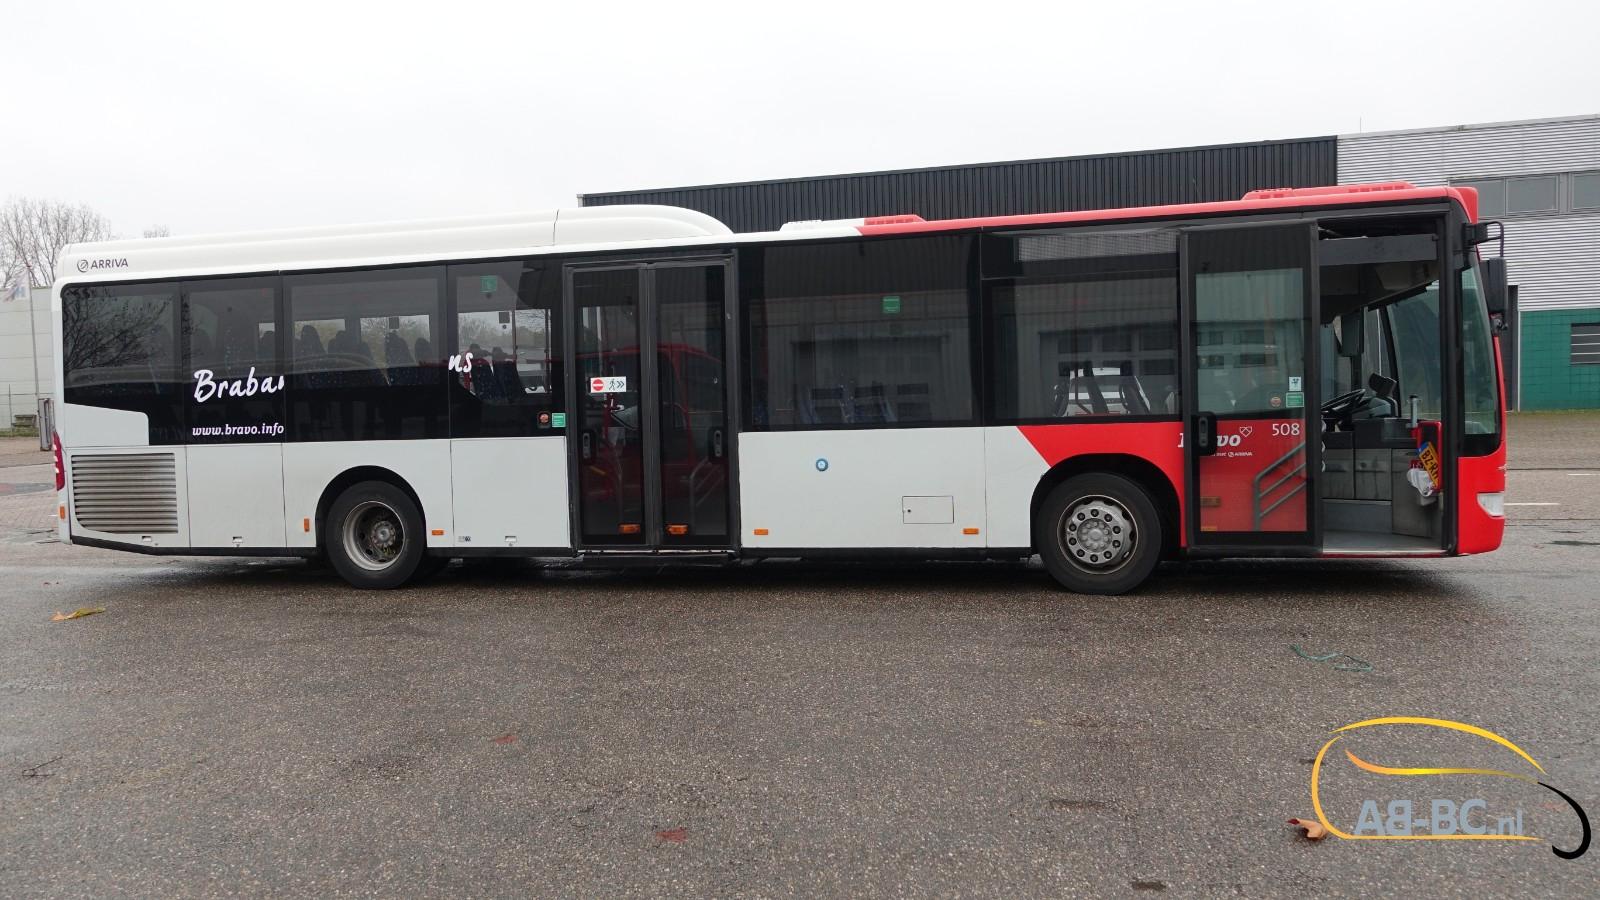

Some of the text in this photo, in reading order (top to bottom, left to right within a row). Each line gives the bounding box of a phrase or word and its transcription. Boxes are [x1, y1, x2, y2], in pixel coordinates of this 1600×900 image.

[90, 258, 129, 270] ARRIVA
[192, 422, 285, 437] www.bravo.info
[1271, 422, 1301, 437] 508
